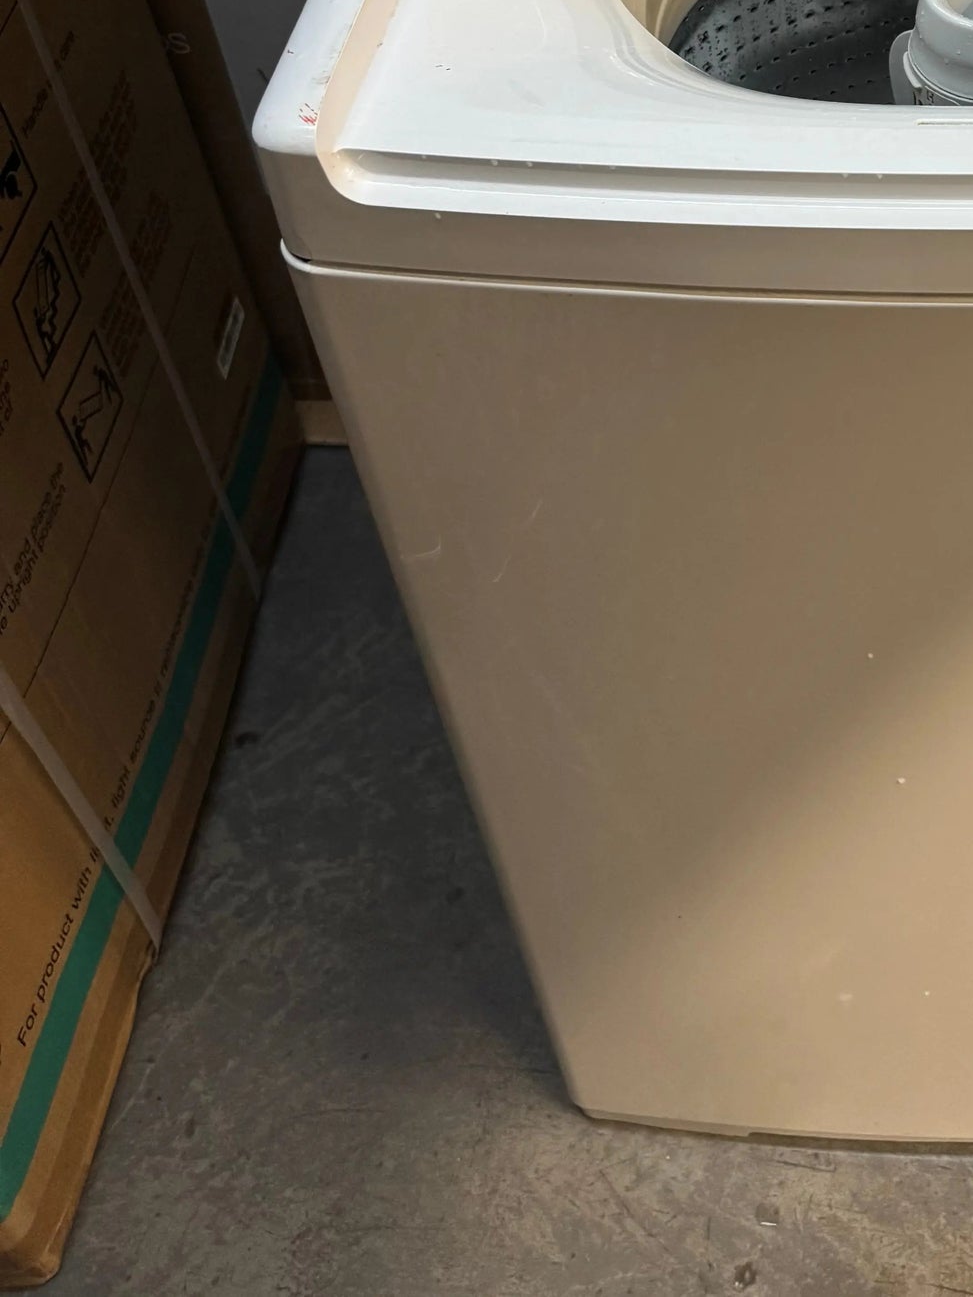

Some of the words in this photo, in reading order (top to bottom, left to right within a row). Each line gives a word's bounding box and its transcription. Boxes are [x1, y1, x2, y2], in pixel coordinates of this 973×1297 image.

[17, 1003, 37, 1048] For
[37, 913, 75, 1004] product
[72, 865, 93, 910] with
[111, 765, 130, 809] light
